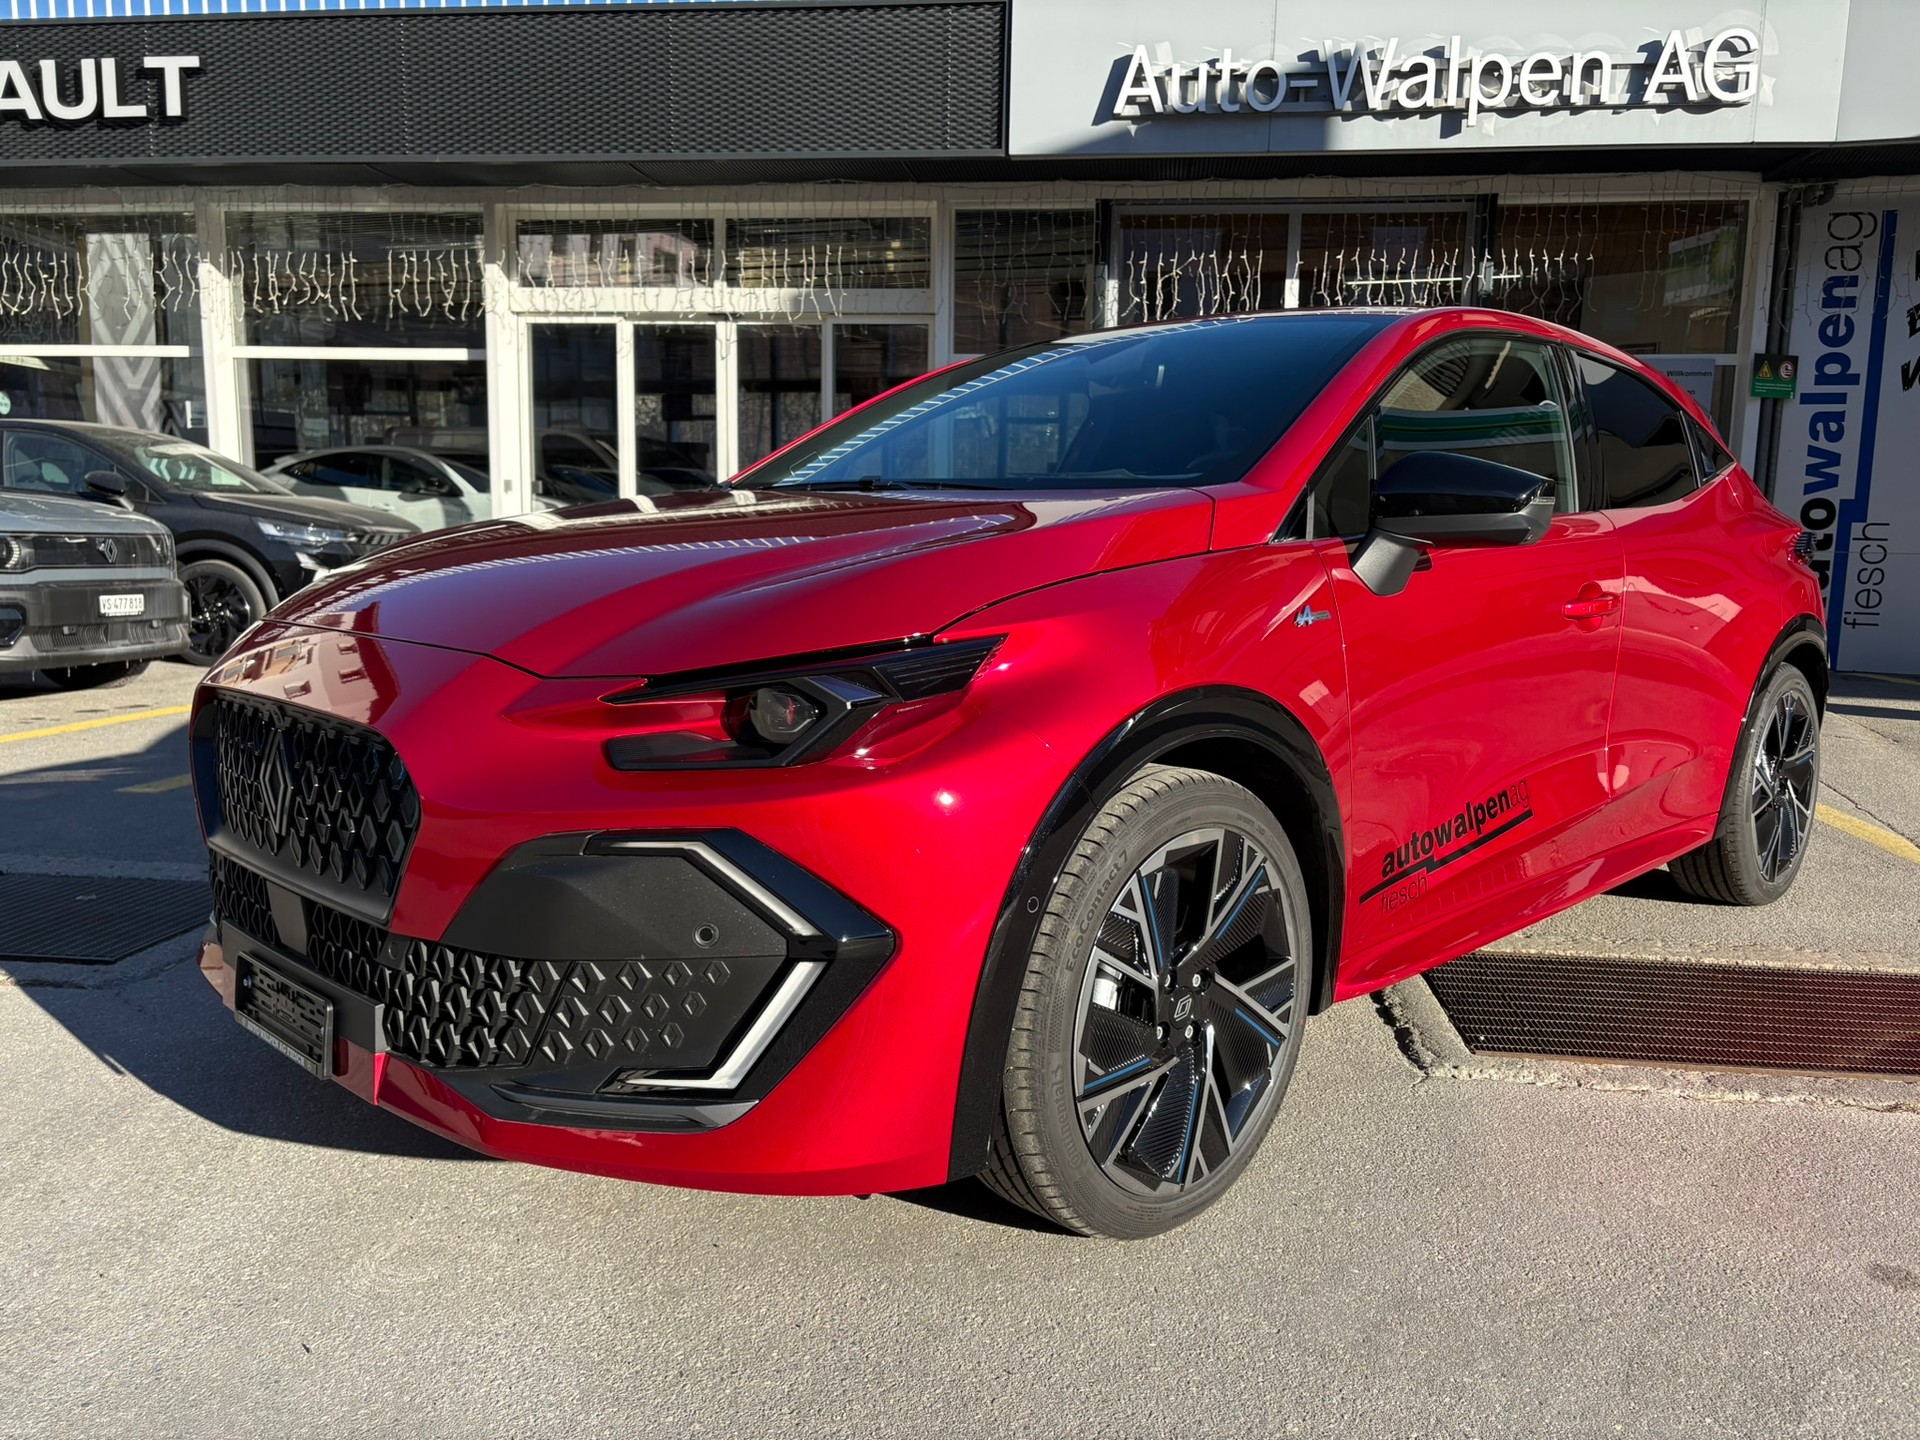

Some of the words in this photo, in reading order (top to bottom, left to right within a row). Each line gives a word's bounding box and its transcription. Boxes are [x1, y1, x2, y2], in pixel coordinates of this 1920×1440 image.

[0, 56, 200, 120] AULT
[1113, 36, 1613, 127] Auto-Walpen
[1643, 28, 1760, 102] AG
[1666, 369, 1713, 377] Willkommen
[1844, 522, 1890, 629] fiesch
[1381, 778, 1530, 878] autowalpenag
[1065, 862, 1123, 972] EcoContact
[1118, 849, 1129, 863] 7
[1379, 874, 1428, 915] fiesch
